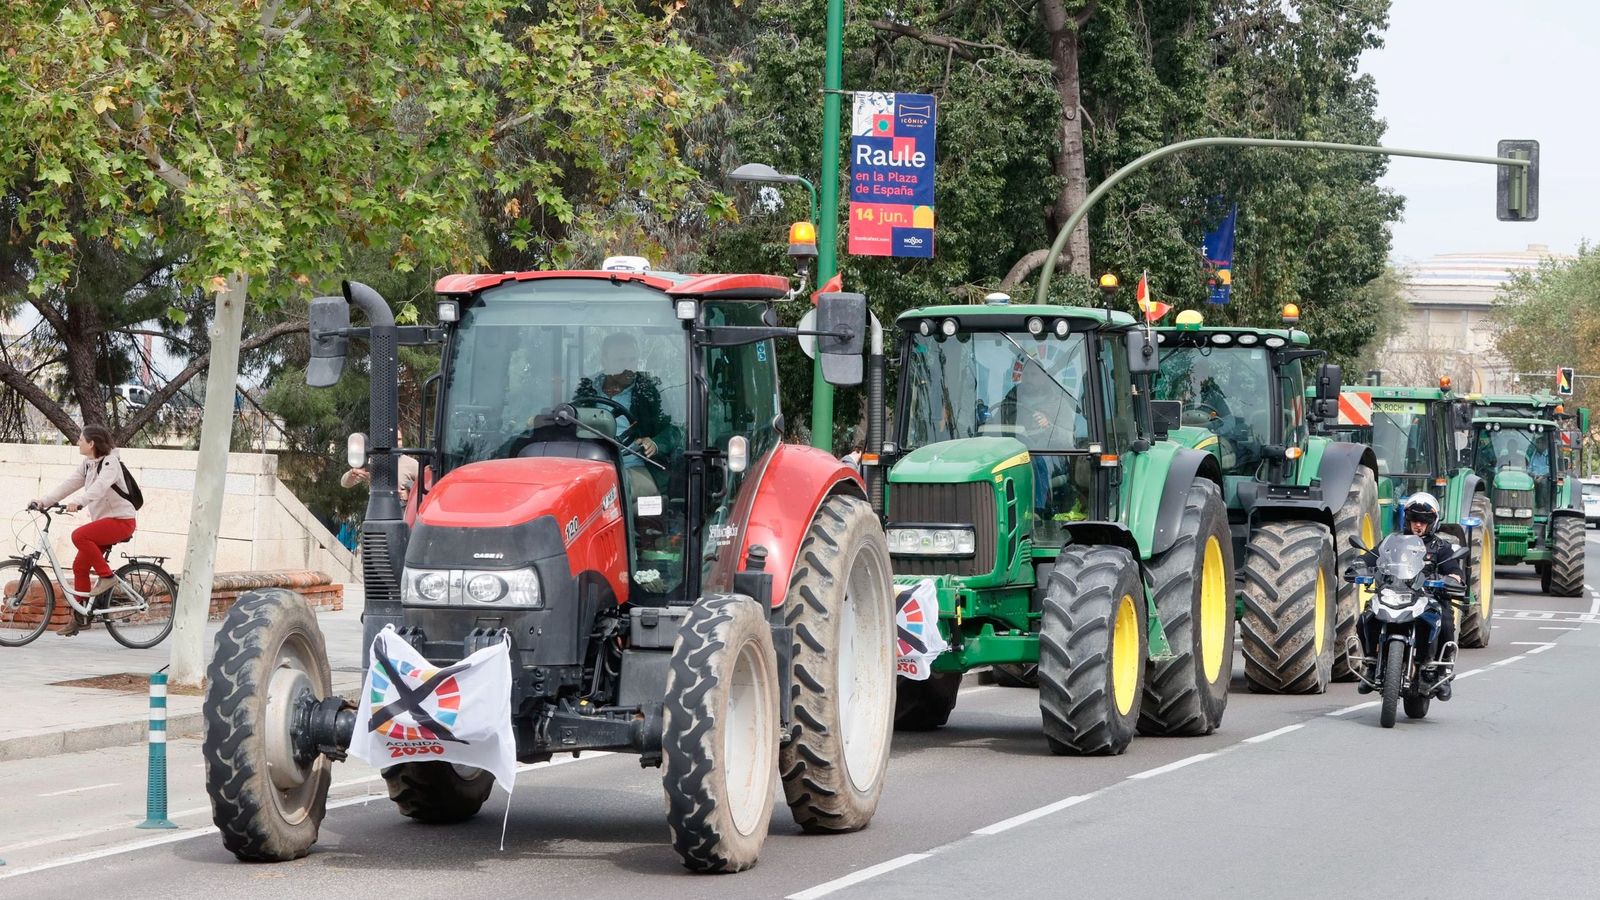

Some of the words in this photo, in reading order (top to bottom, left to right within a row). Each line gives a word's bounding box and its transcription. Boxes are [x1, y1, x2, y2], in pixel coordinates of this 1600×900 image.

[856, 144, 926, 168] Raule
[855, 172, 870, 181] en
[873, 171, 884, 182] la
[888, 172, 918, 184] Plaza
[855, 183, 869, 194] de
[873, 184, 914, 197] España
[855, 207, 874, 222] 14
[877, 208, 908, 225] jun.
[564, 515, 579, 541] 120
[388, 745, 445, 758] 2030
